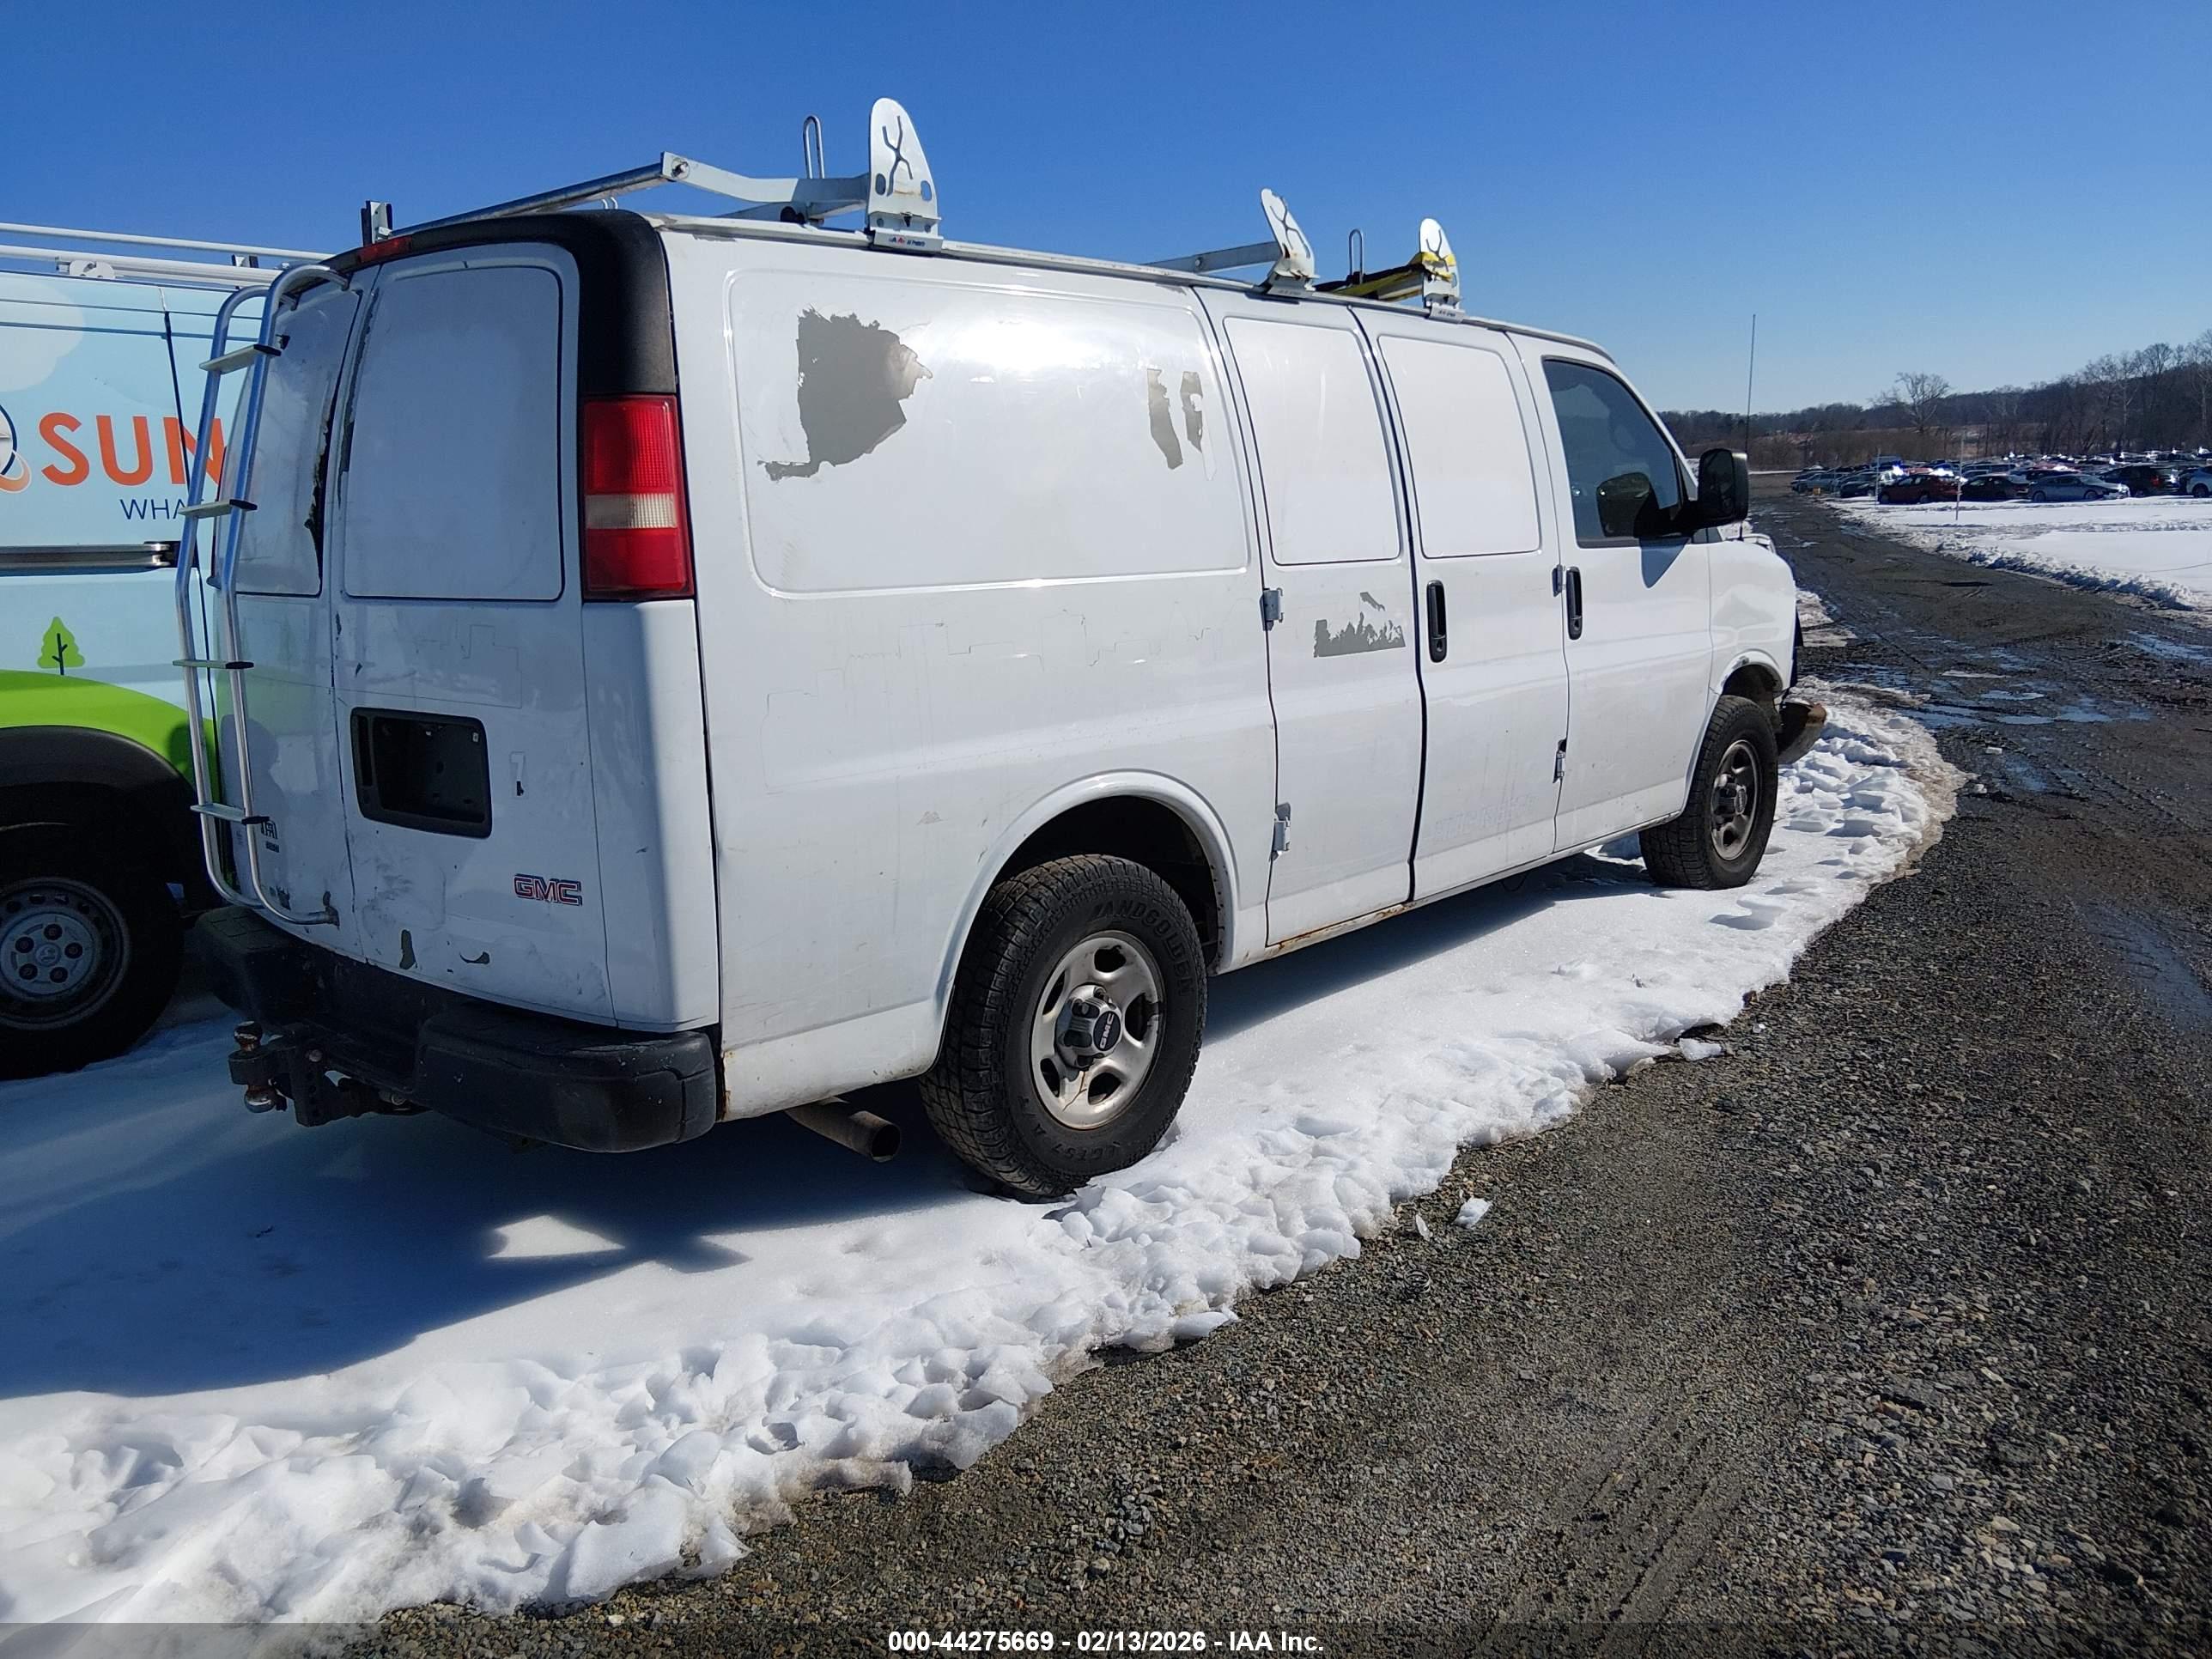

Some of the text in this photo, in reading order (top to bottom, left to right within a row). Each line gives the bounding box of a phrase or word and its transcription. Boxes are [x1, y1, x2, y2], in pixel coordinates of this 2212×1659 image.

[39, 412, 227, 486] SUN
[119, 498, 204, 520] WHA
[514, 873, 582, 906] GMC
[1099, 1012, 1115, 1049] GMC
